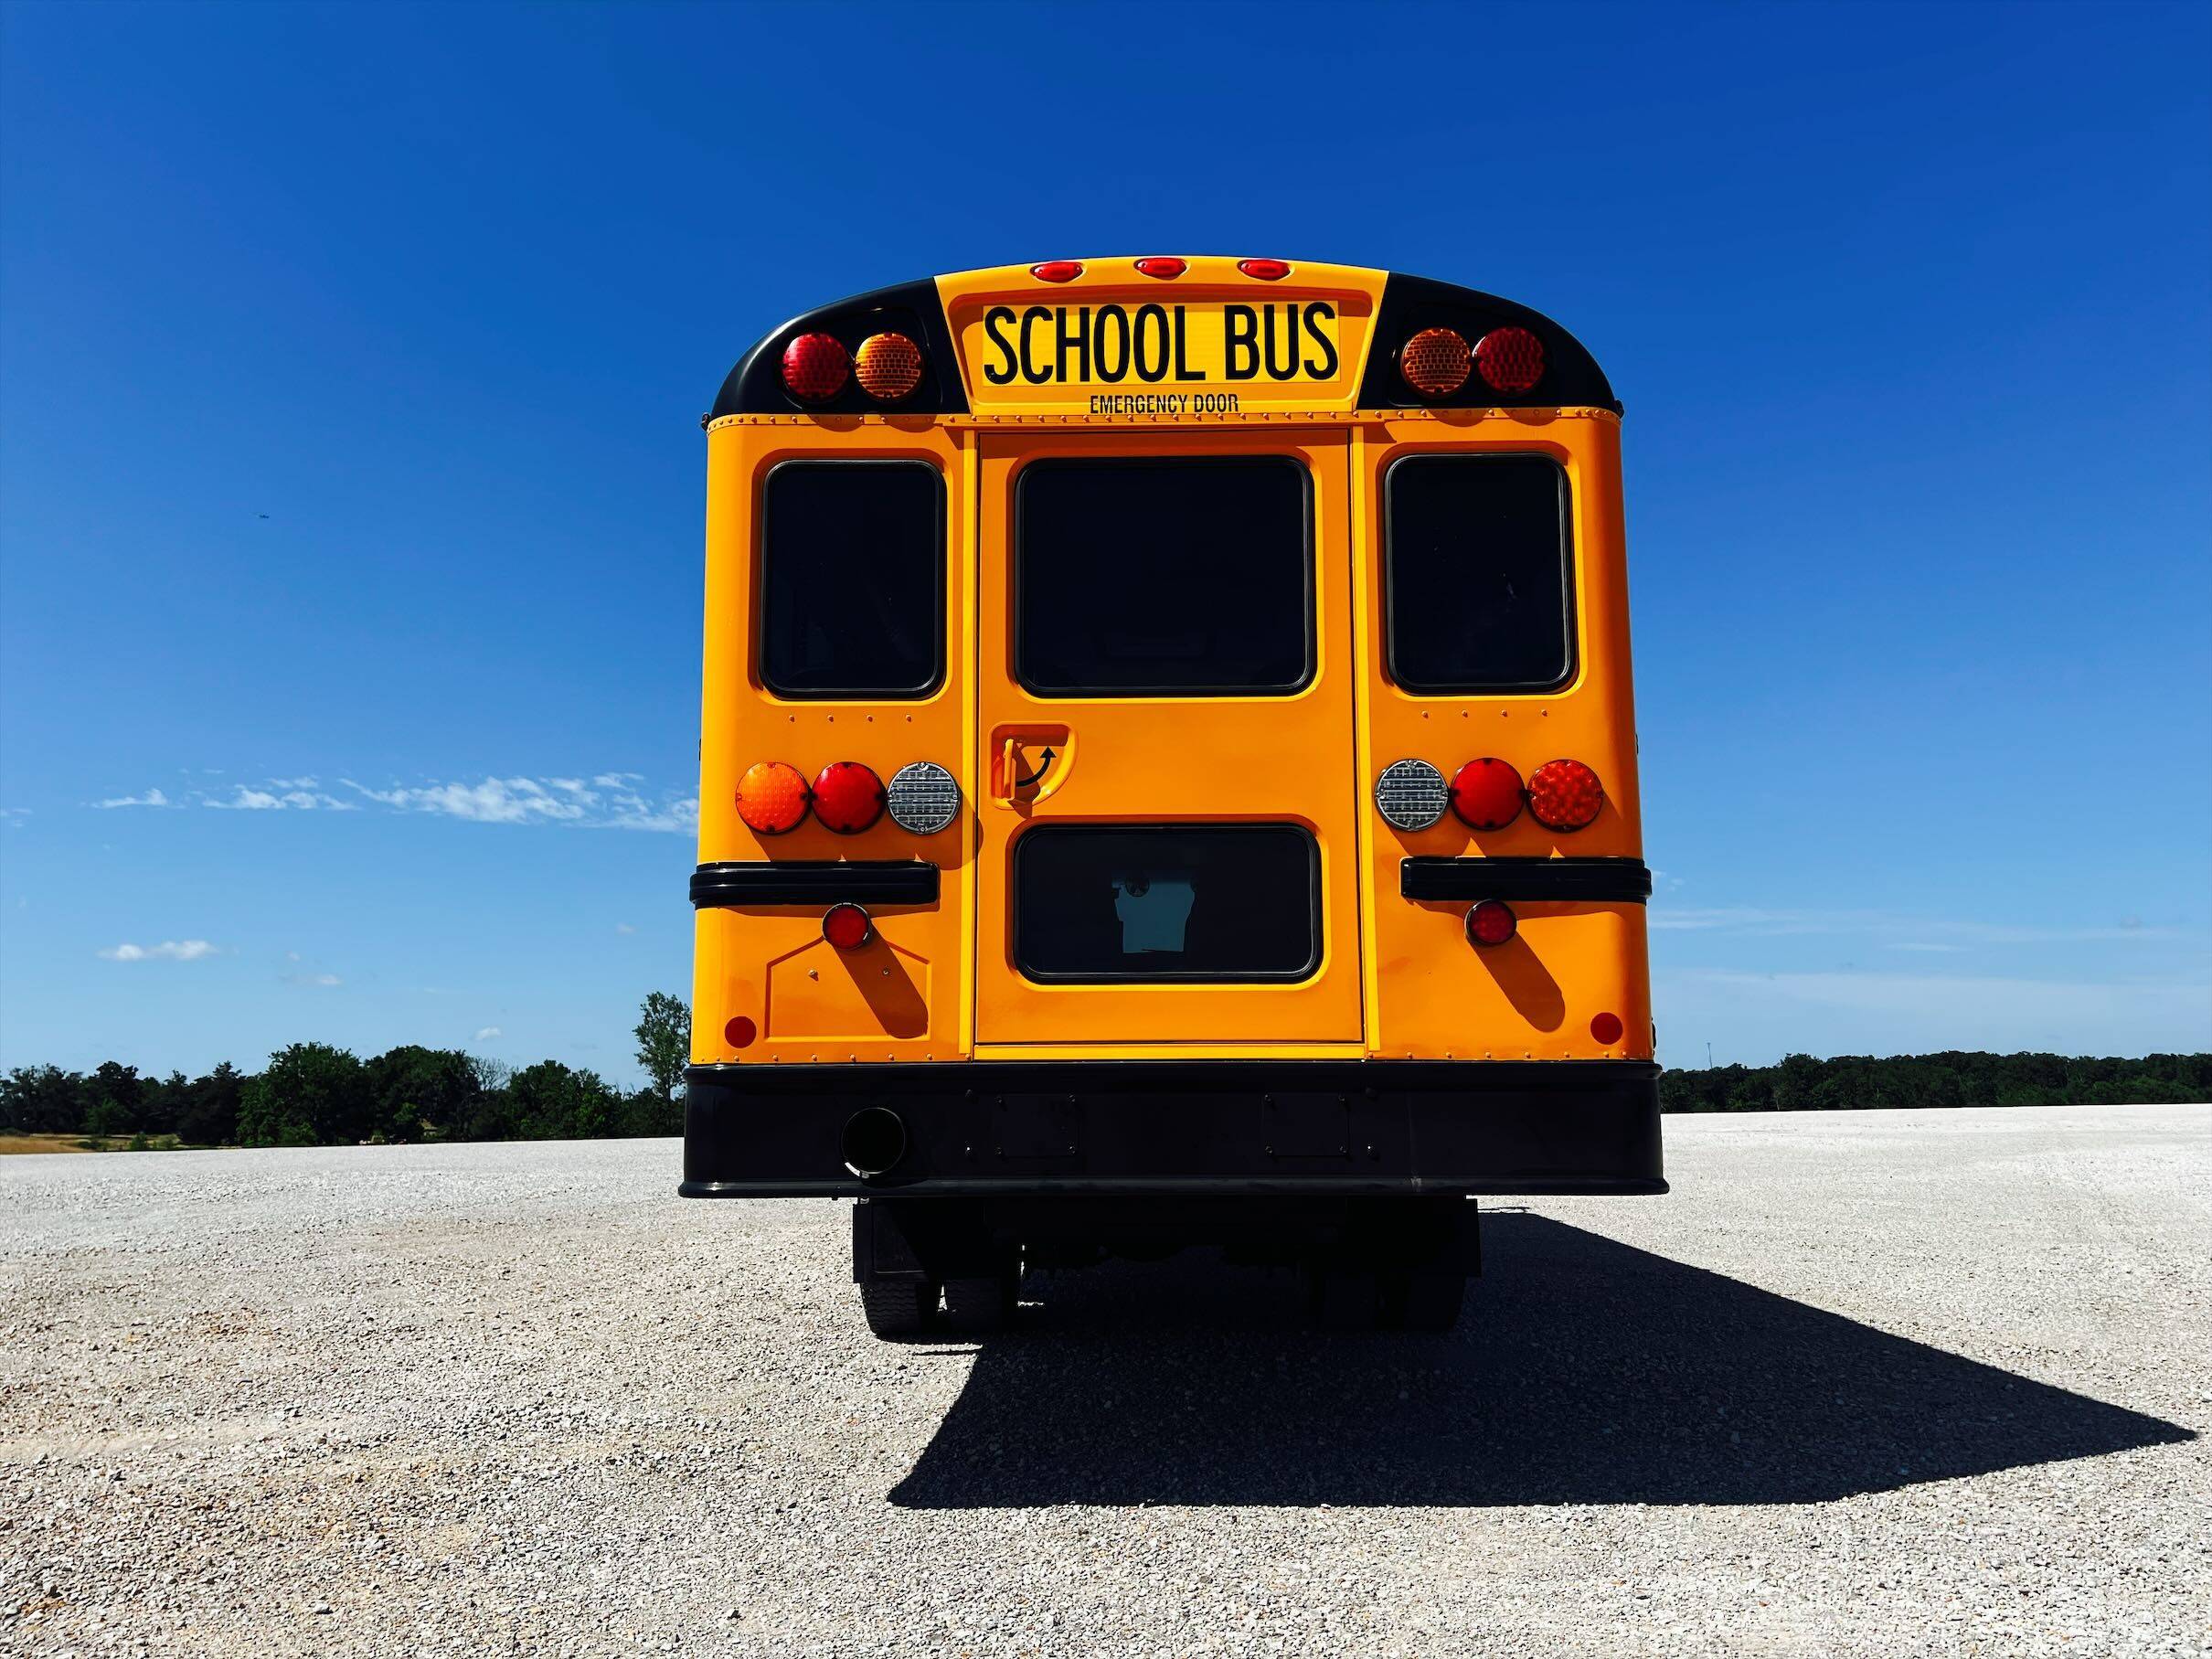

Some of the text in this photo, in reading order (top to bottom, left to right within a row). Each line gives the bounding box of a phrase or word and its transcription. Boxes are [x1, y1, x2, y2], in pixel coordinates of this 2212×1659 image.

[984, 301, 1339, 385] SCHOOL BUS
[1090, 393, 1239, 414] EMERGENCY DOOR
